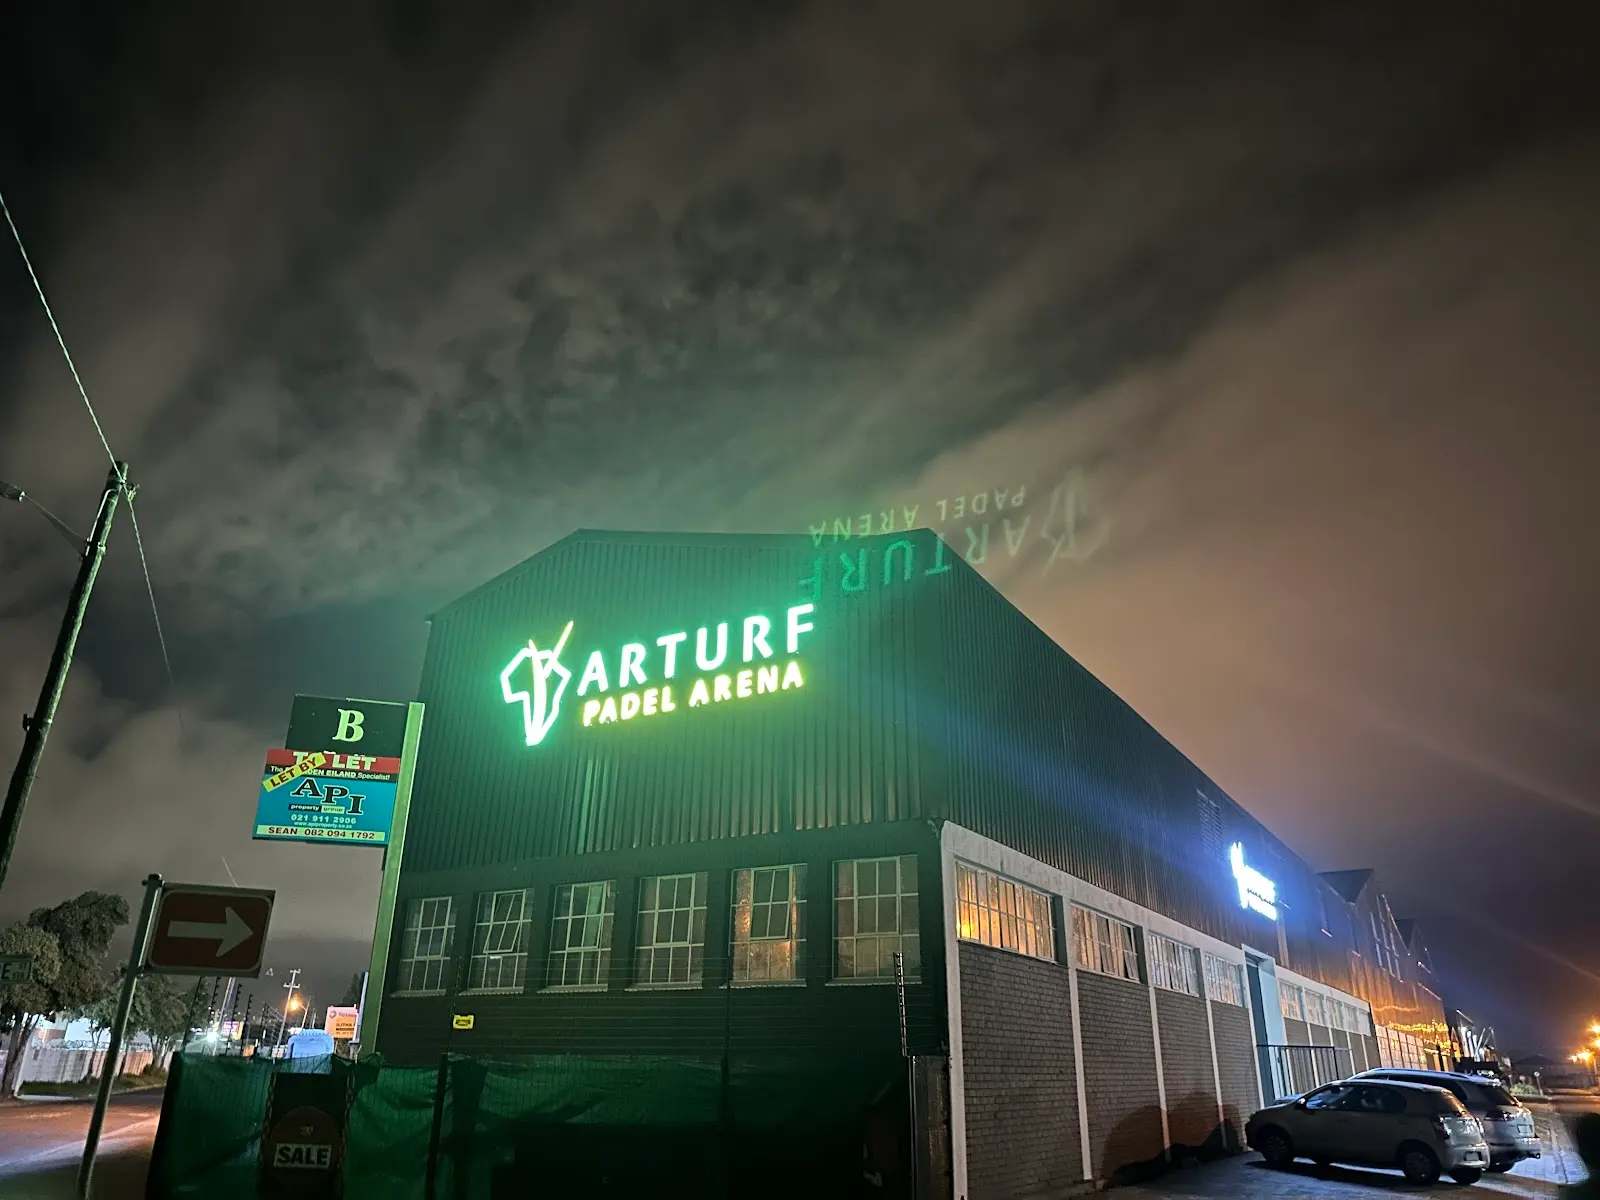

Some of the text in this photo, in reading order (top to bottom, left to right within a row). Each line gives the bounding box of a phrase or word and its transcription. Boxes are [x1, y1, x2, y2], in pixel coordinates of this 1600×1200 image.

[577, 603, 814, 696] ARTURF
[583, 661, 803, 727] PADEL ARENA
[332, 709, 364, 742] B
[270, 768, 296, 787] LET
[299, 759, 317, 773] BY
[326, 769, 357, 779] EILAND
[332, 754, 376, 770] LET
[290, 777, 366, 815] API
[291, 813, 357, 825] 021 911 2906
[268, 827, 298, 835] SEAN
[304, 828, 324, 836] 082
[327, 830, 346, 838] 094
[277, 1146, 329, 1166] SALE
